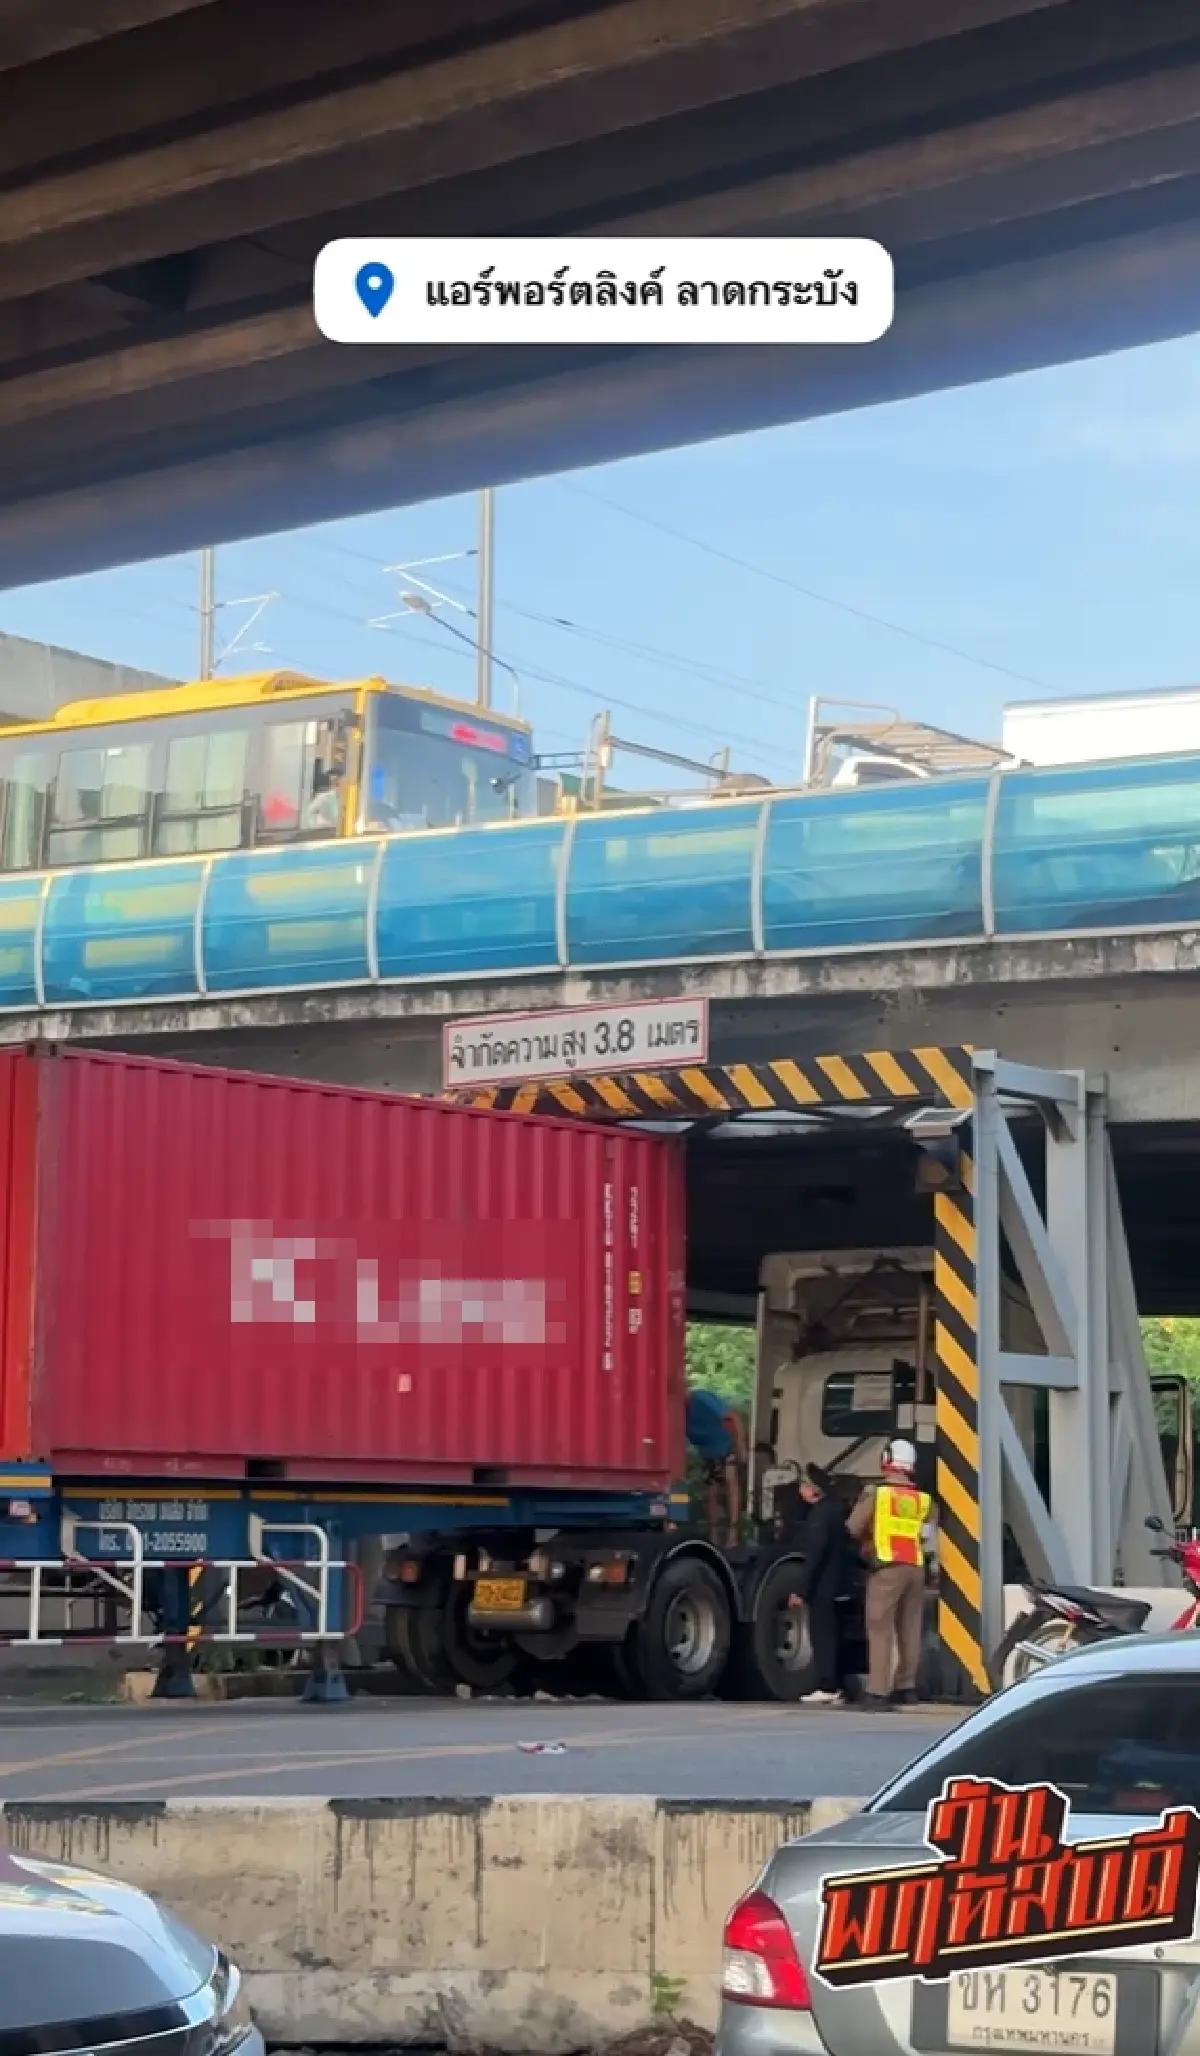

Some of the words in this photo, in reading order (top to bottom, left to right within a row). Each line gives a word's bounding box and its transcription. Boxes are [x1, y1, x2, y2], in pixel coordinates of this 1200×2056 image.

[450, 1030, 587, 1069] จำกัดความสูง
[594, 1018, 635, 1055] 3.8
[647, 1019, 699, 1048] เมตร
[1022, 1973, 1111, 2018] 3176
